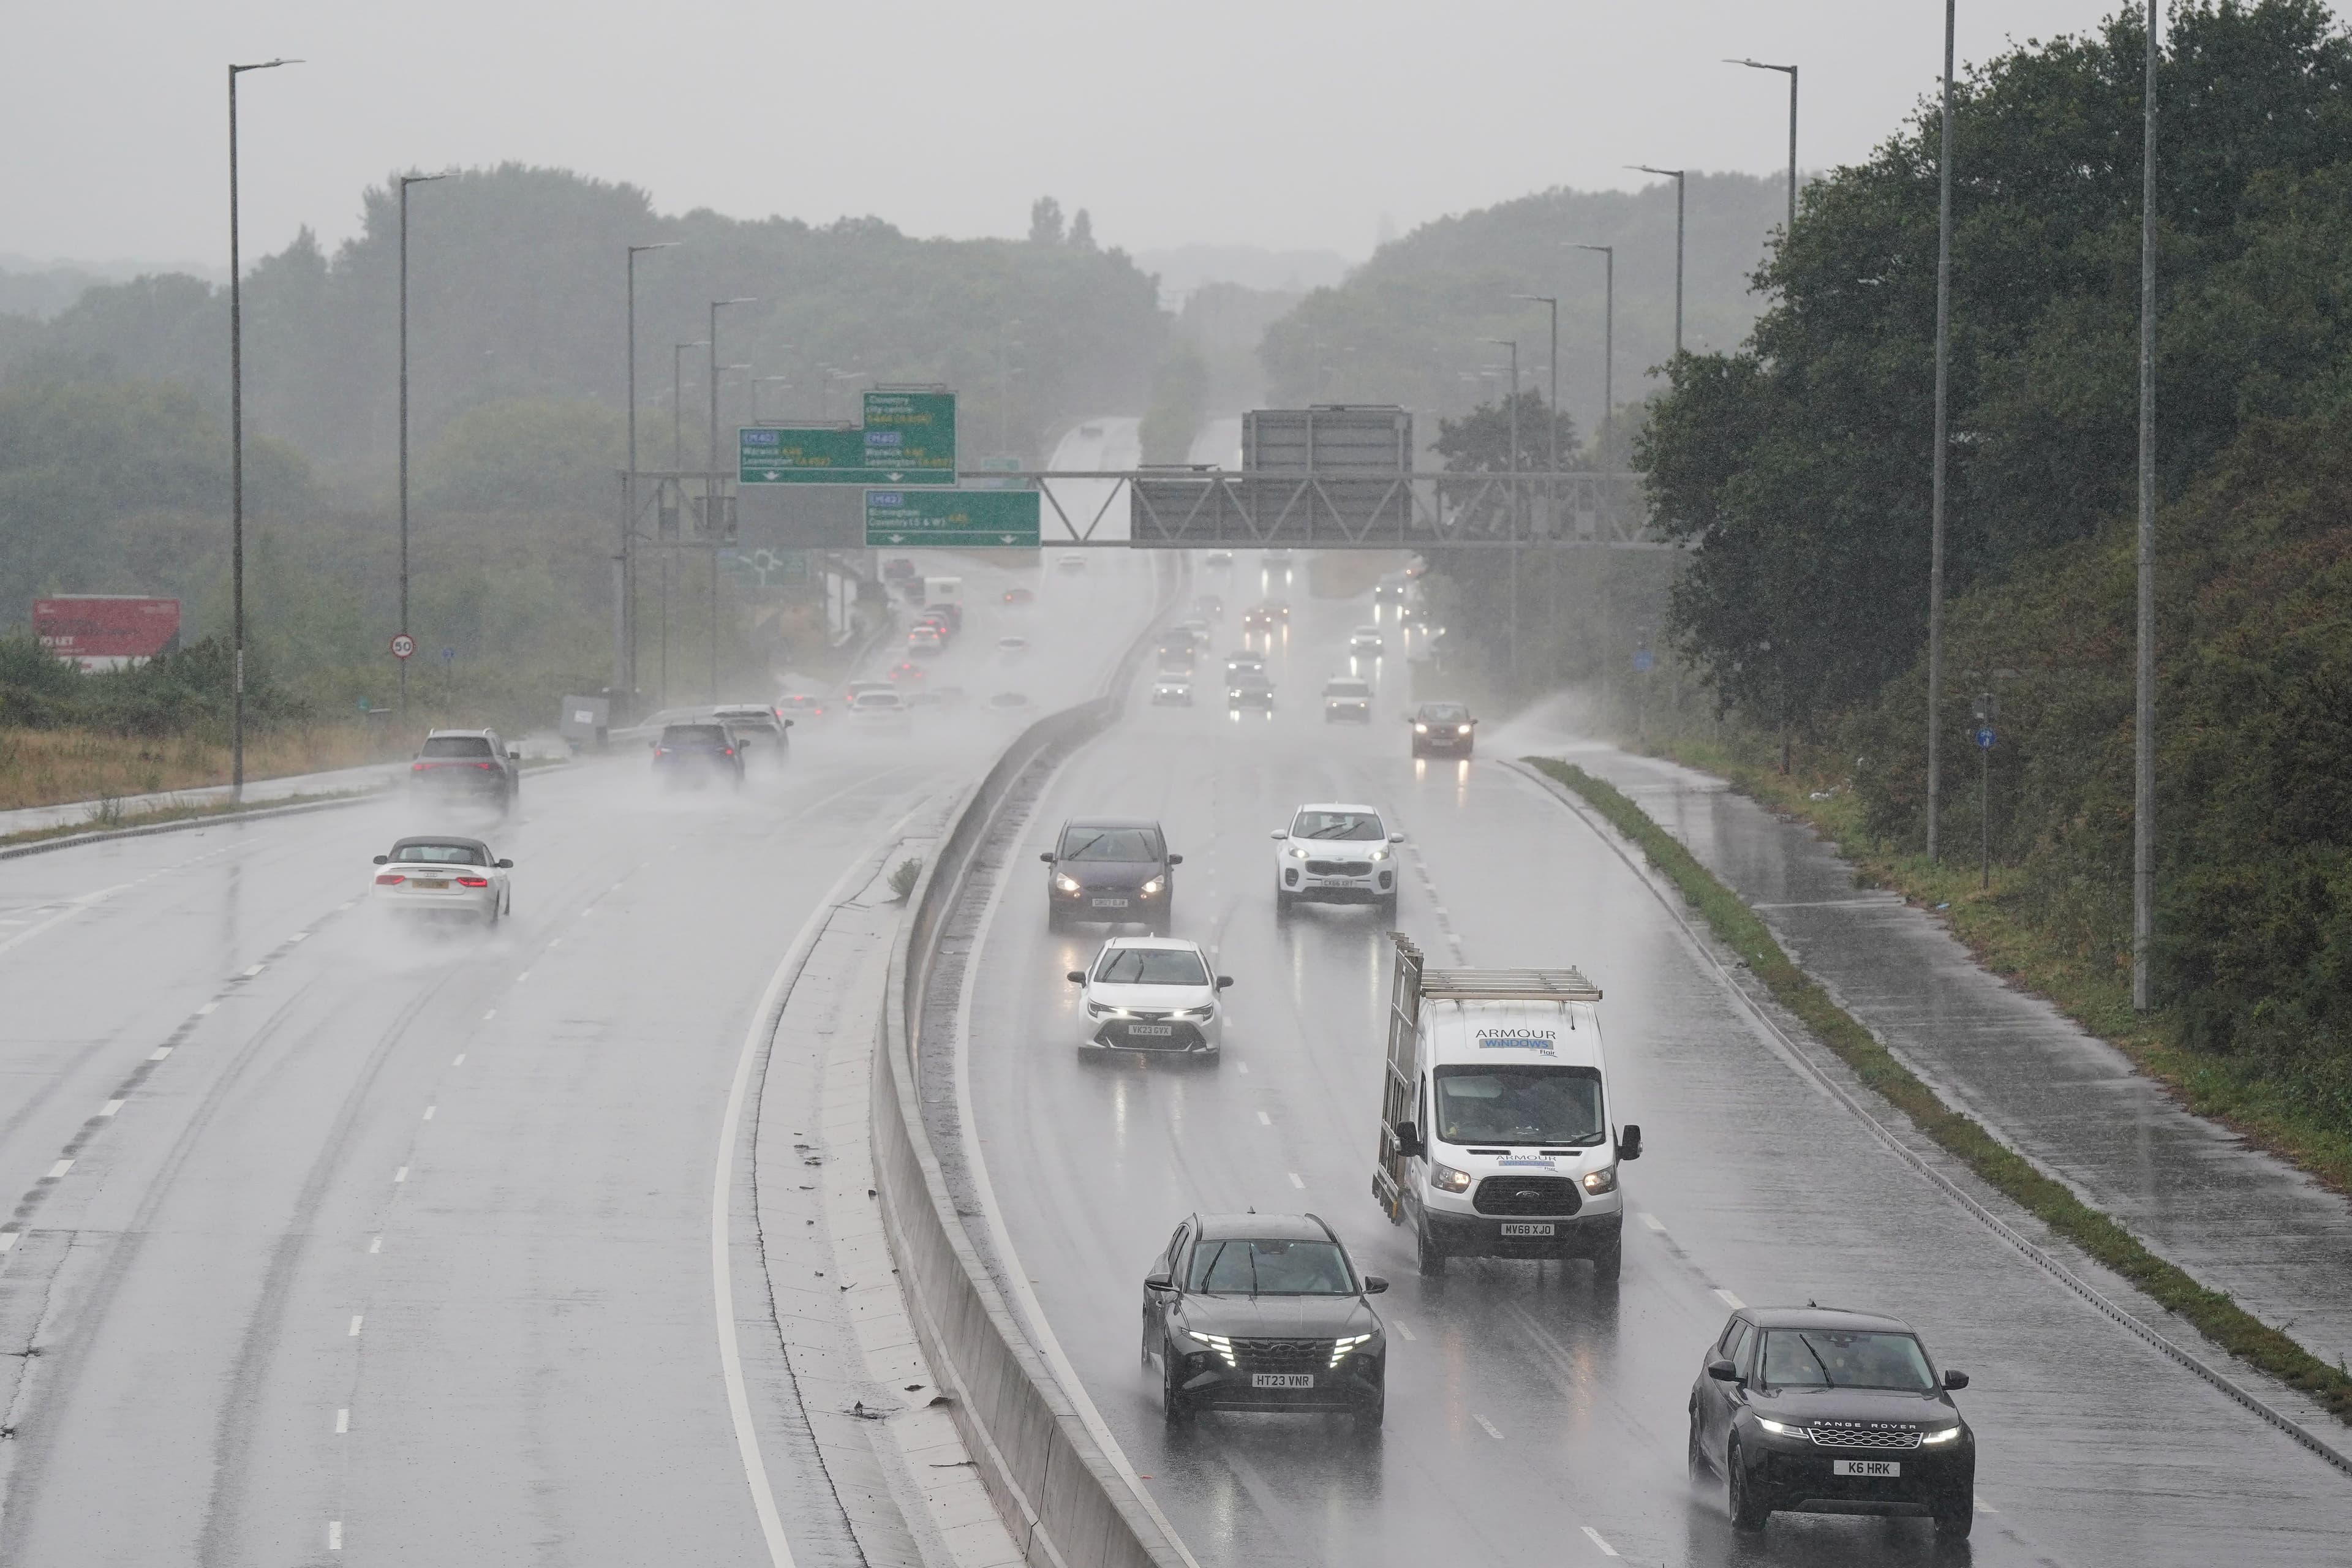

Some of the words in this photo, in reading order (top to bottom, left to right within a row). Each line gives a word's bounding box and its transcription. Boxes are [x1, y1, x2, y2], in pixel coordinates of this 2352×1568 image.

[396, 641, 411, 651] 50
[1475, 1029, 1556, 1040] ARMOUR
[1506, 1224, 1530, 1234] MV68
[1532, 1225, 1551, 1235] XJO
[1257, 1375, 1285, 1385] HT23
[1288, 1376, 1309, 1386] VNR
[1849, 1461, 1864, 1473] K6
[1867, 1463, 1890, 1474] HRK
